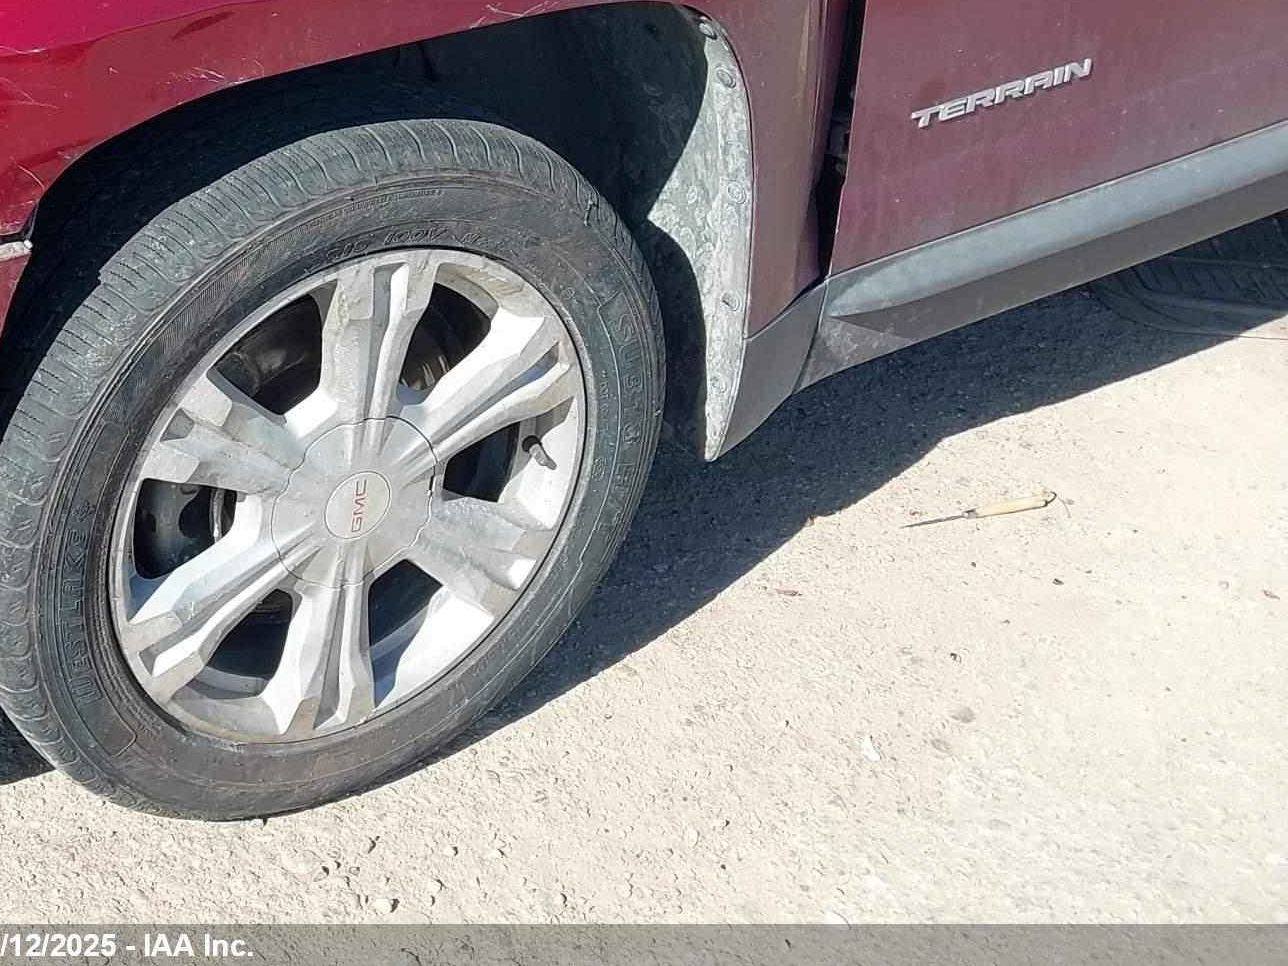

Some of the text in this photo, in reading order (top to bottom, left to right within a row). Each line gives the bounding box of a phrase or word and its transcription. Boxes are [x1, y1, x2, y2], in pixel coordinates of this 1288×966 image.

[911, 58, 1093, 129] TERRAIN
[350, 479, 367, 533] GMC
[57, 529, 102, 707] WESTLAKE
